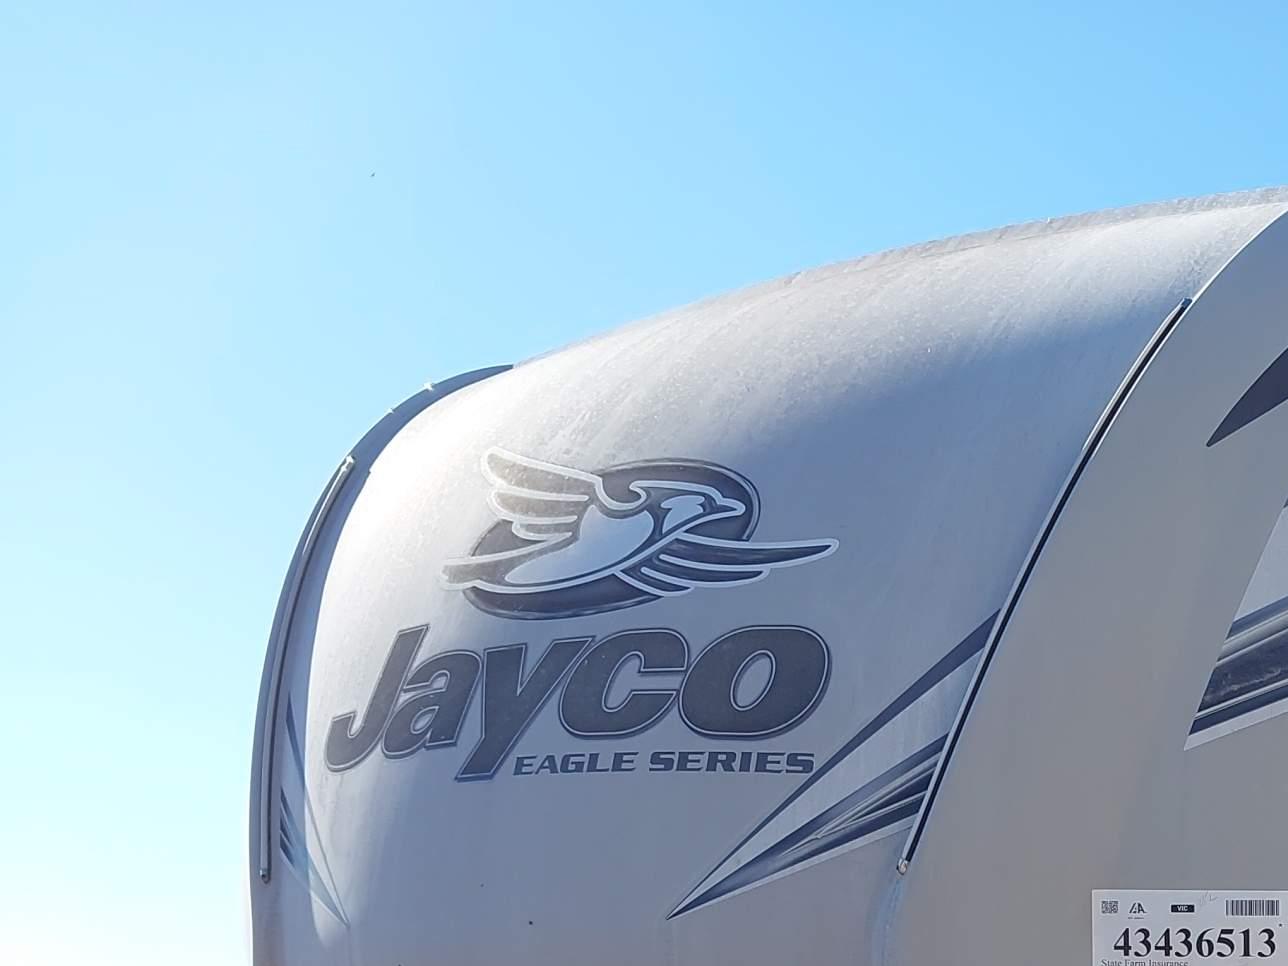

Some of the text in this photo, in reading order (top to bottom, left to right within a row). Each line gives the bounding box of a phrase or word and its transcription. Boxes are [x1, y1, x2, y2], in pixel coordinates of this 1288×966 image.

[324, 623, 832, 783] Jayco
[513, 751, 816, 777] EAGLE SERIES
[1113, 927, 1277, 958] 43436513
